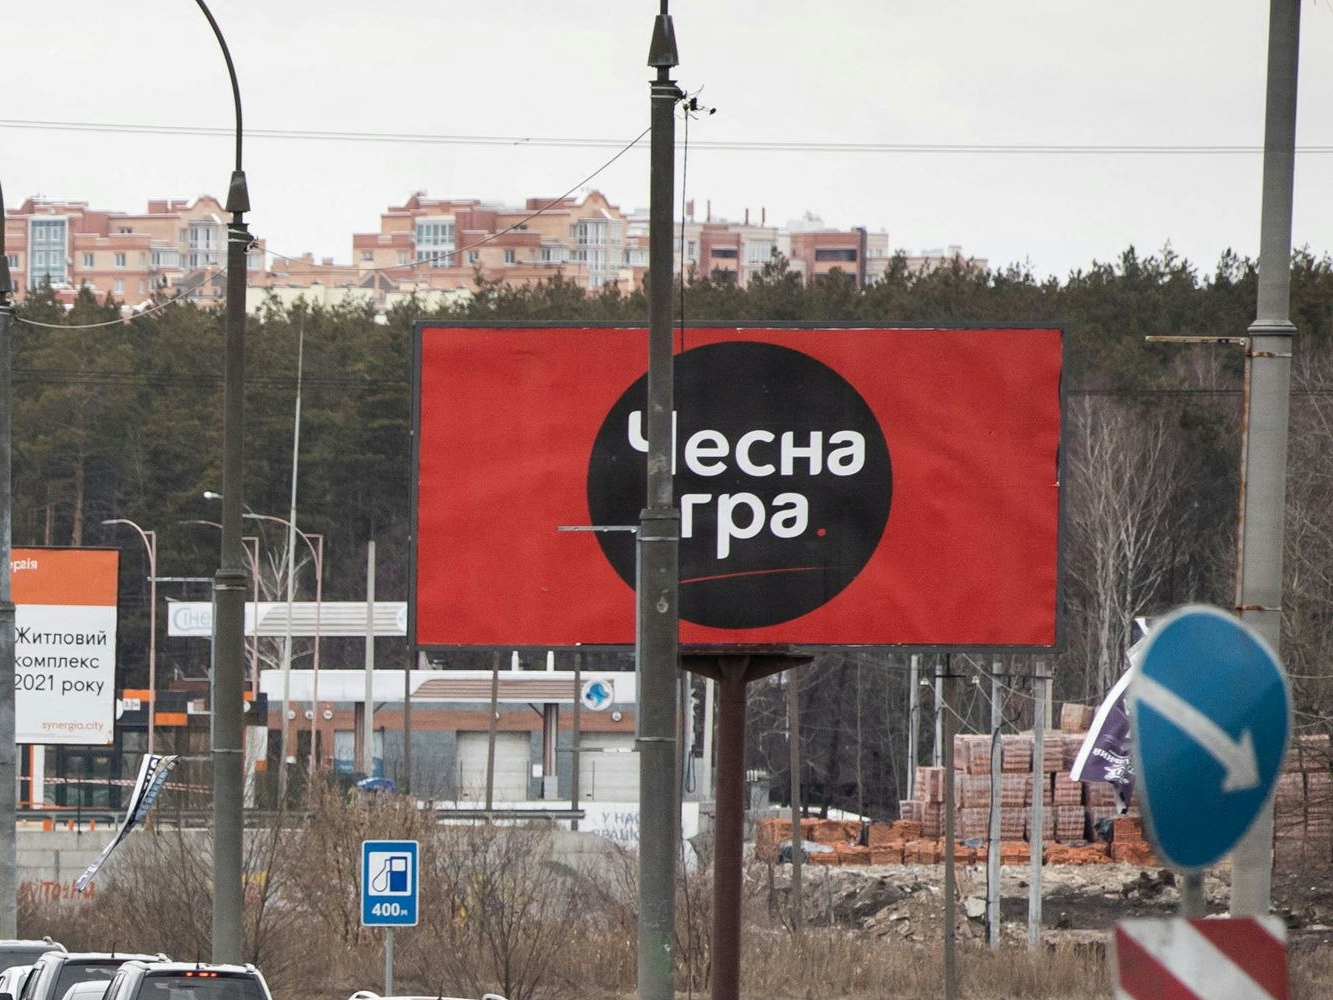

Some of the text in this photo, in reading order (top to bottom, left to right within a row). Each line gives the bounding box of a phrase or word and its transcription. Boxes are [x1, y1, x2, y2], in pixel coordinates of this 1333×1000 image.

[14, 627, 107, 646] Житловий
[14, 674, 105, 696] 2021 року
[42, 722, 104, 732] synergia.city
